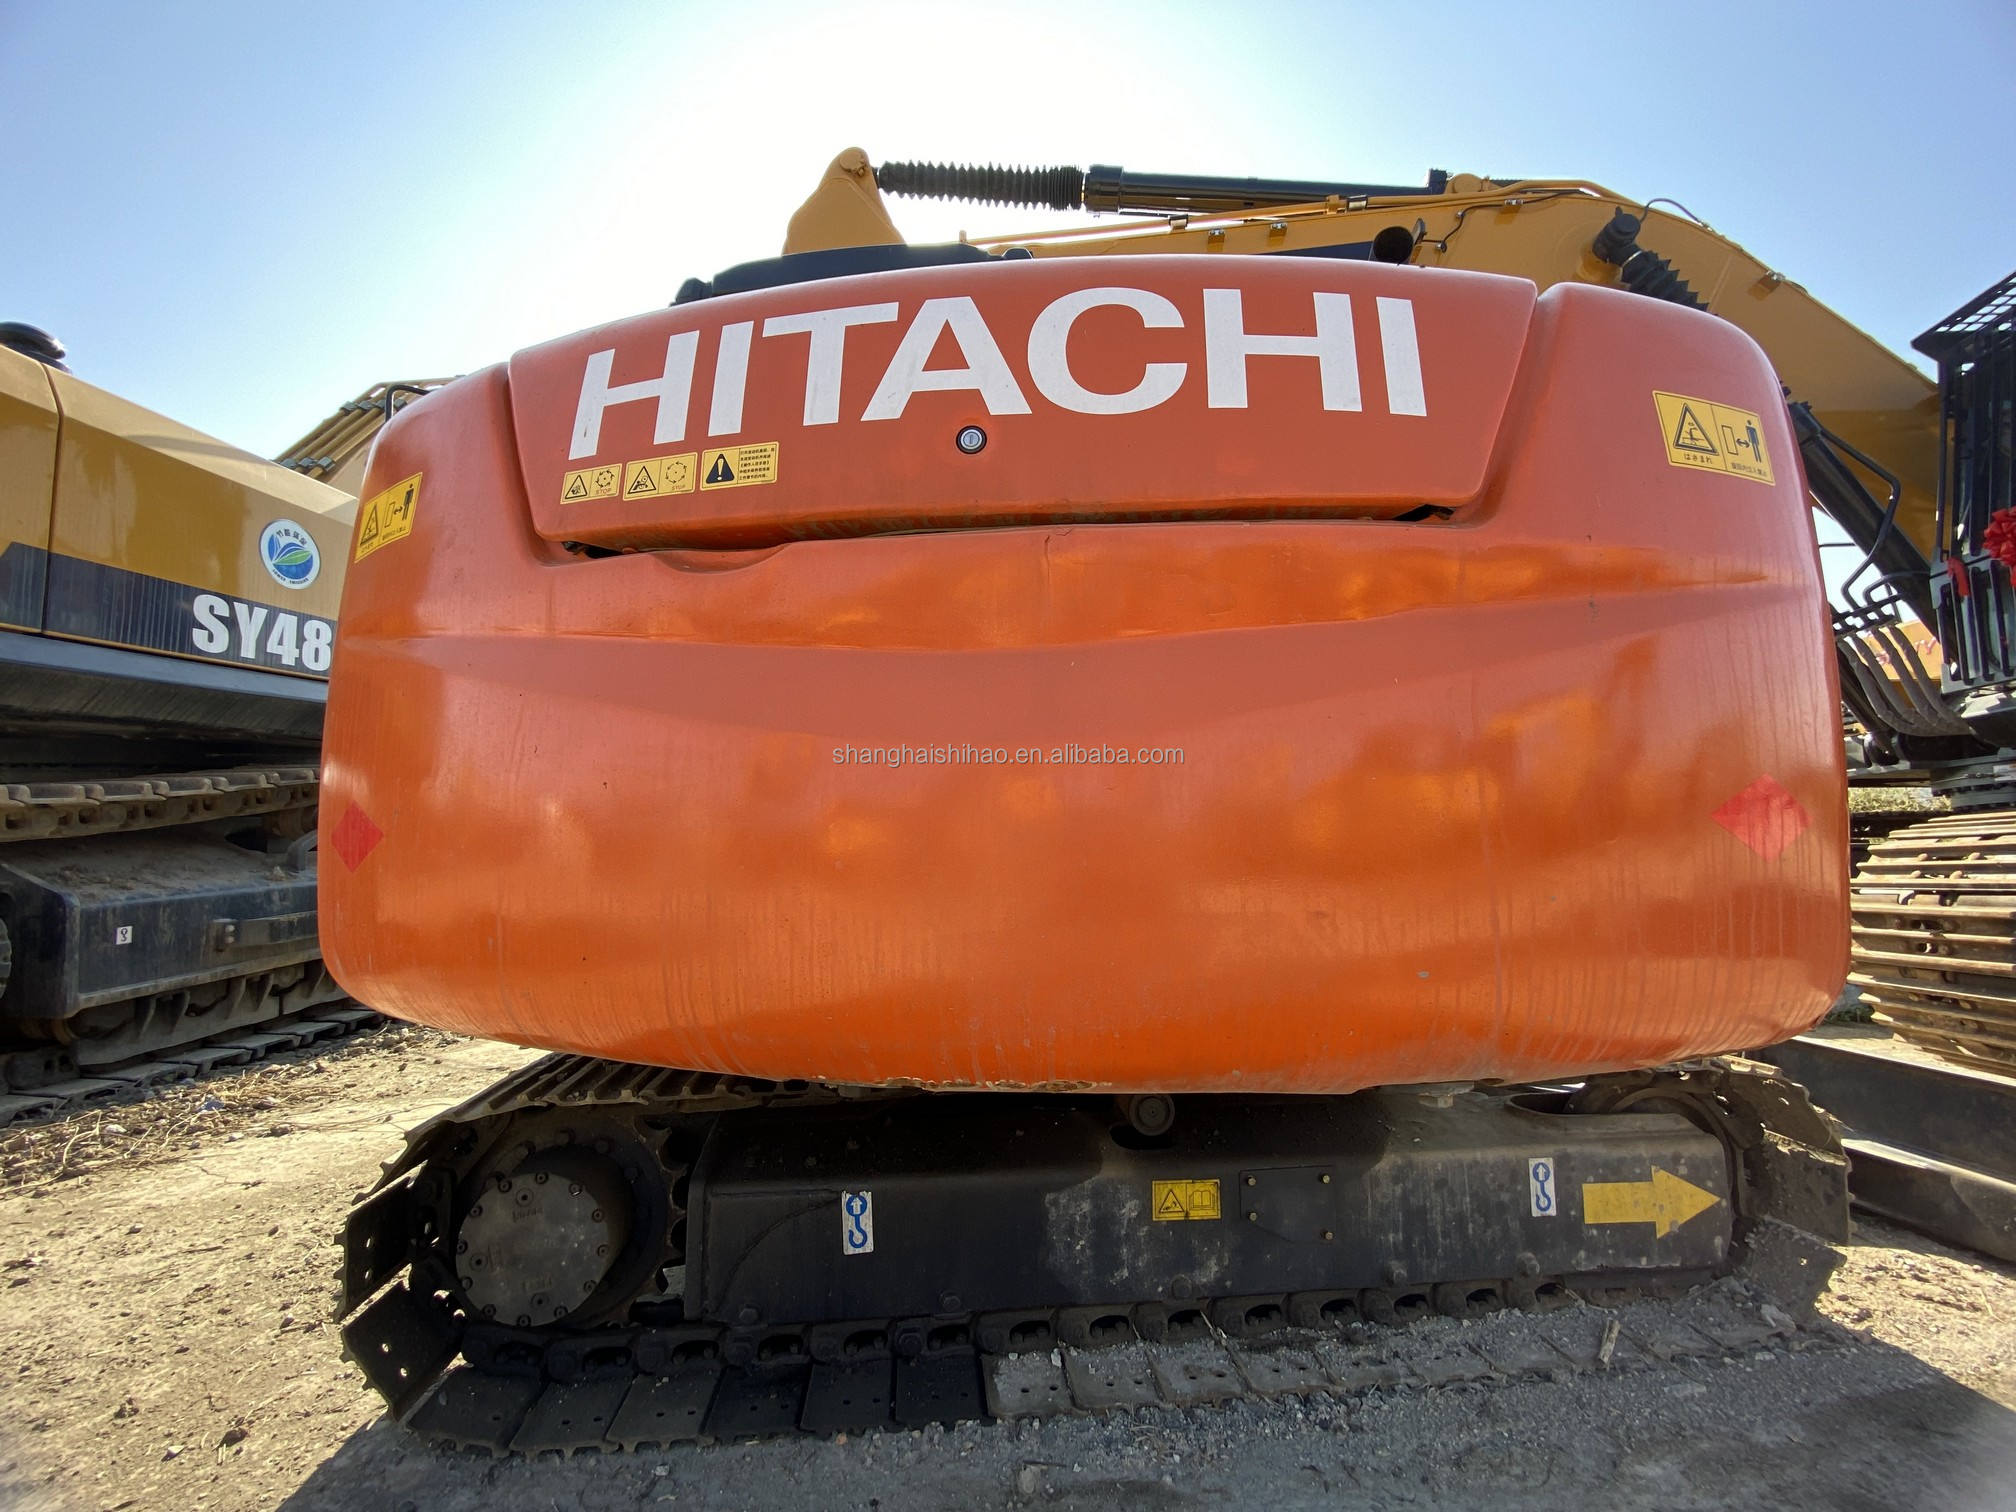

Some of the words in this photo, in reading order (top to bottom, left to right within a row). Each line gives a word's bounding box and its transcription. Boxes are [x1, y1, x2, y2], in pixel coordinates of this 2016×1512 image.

[567, 287, 1428, 460] HITACHI
[596, 487, 612, 495] STOP
[192, 594, 332, 671] SY48
